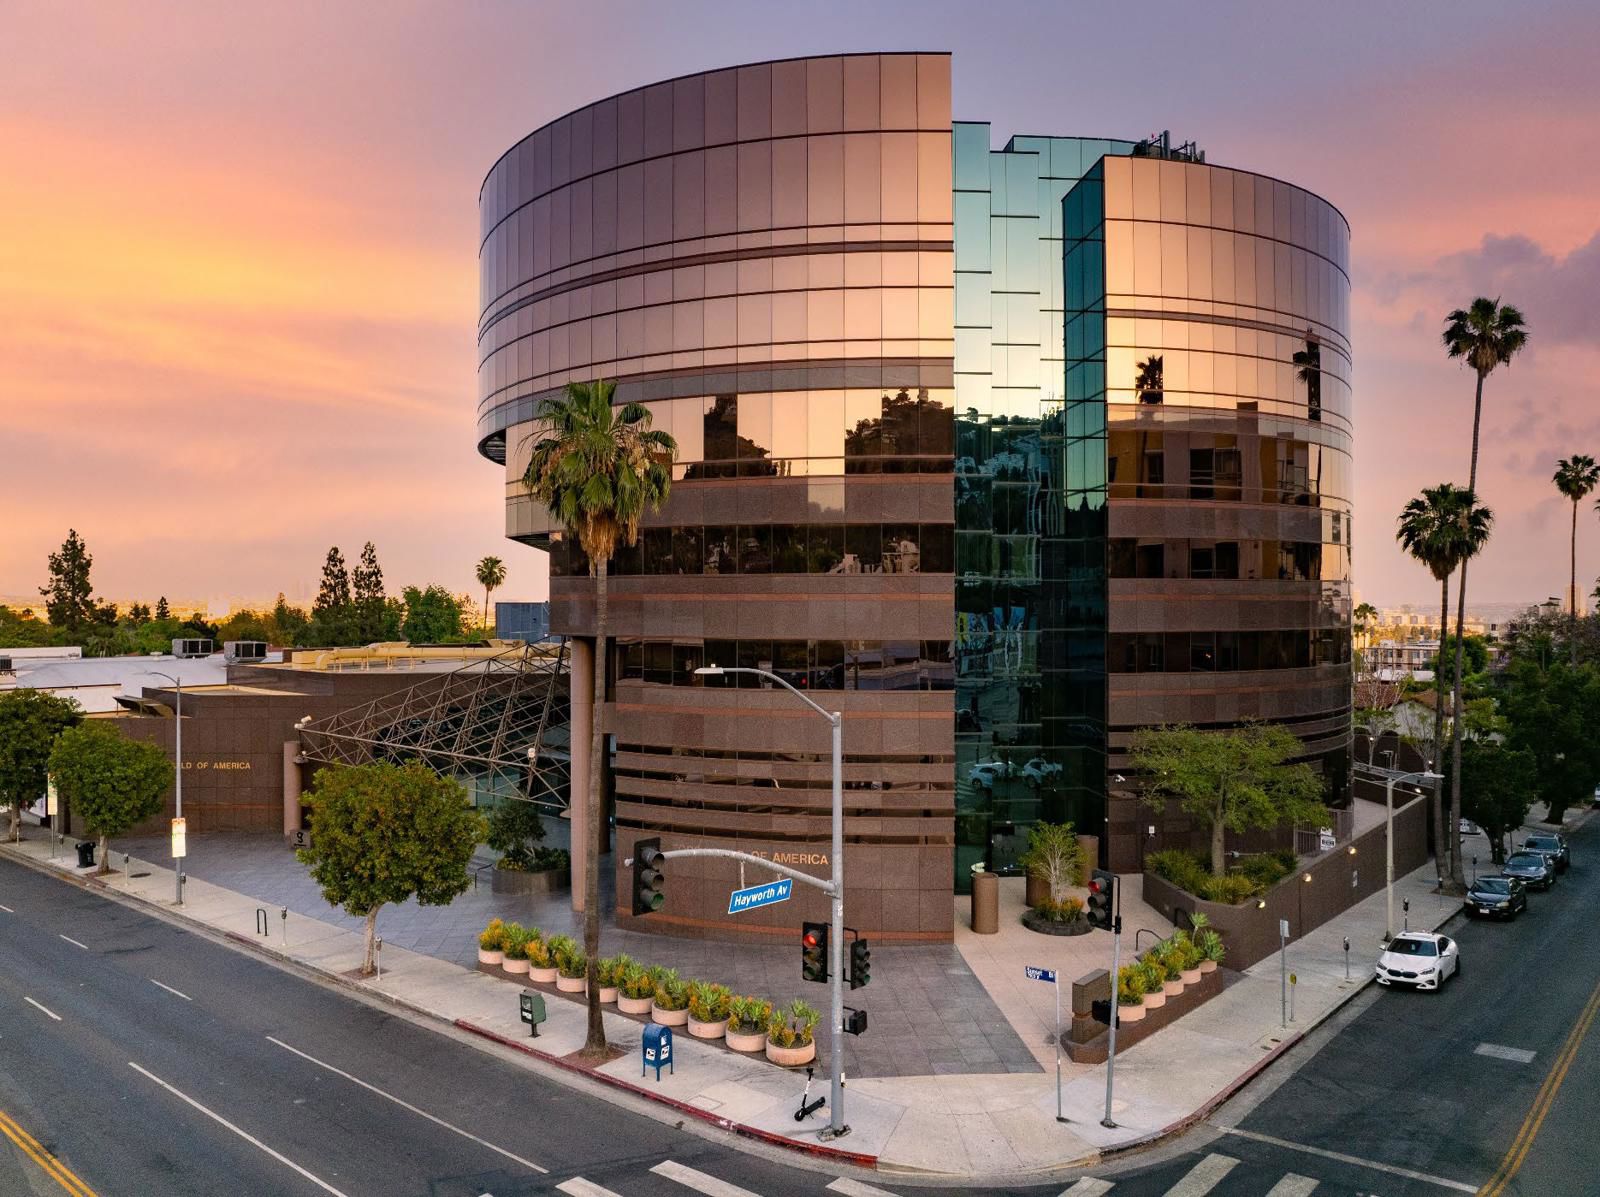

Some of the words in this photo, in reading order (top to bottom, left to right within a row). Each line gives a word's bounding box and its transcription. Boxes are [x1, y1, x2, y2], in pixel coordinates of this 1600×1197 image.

[772, 852, 829, 865] AMERICA
[734, 888, 775, 907] Hayworth
[777, 885, 788, 896] Av
